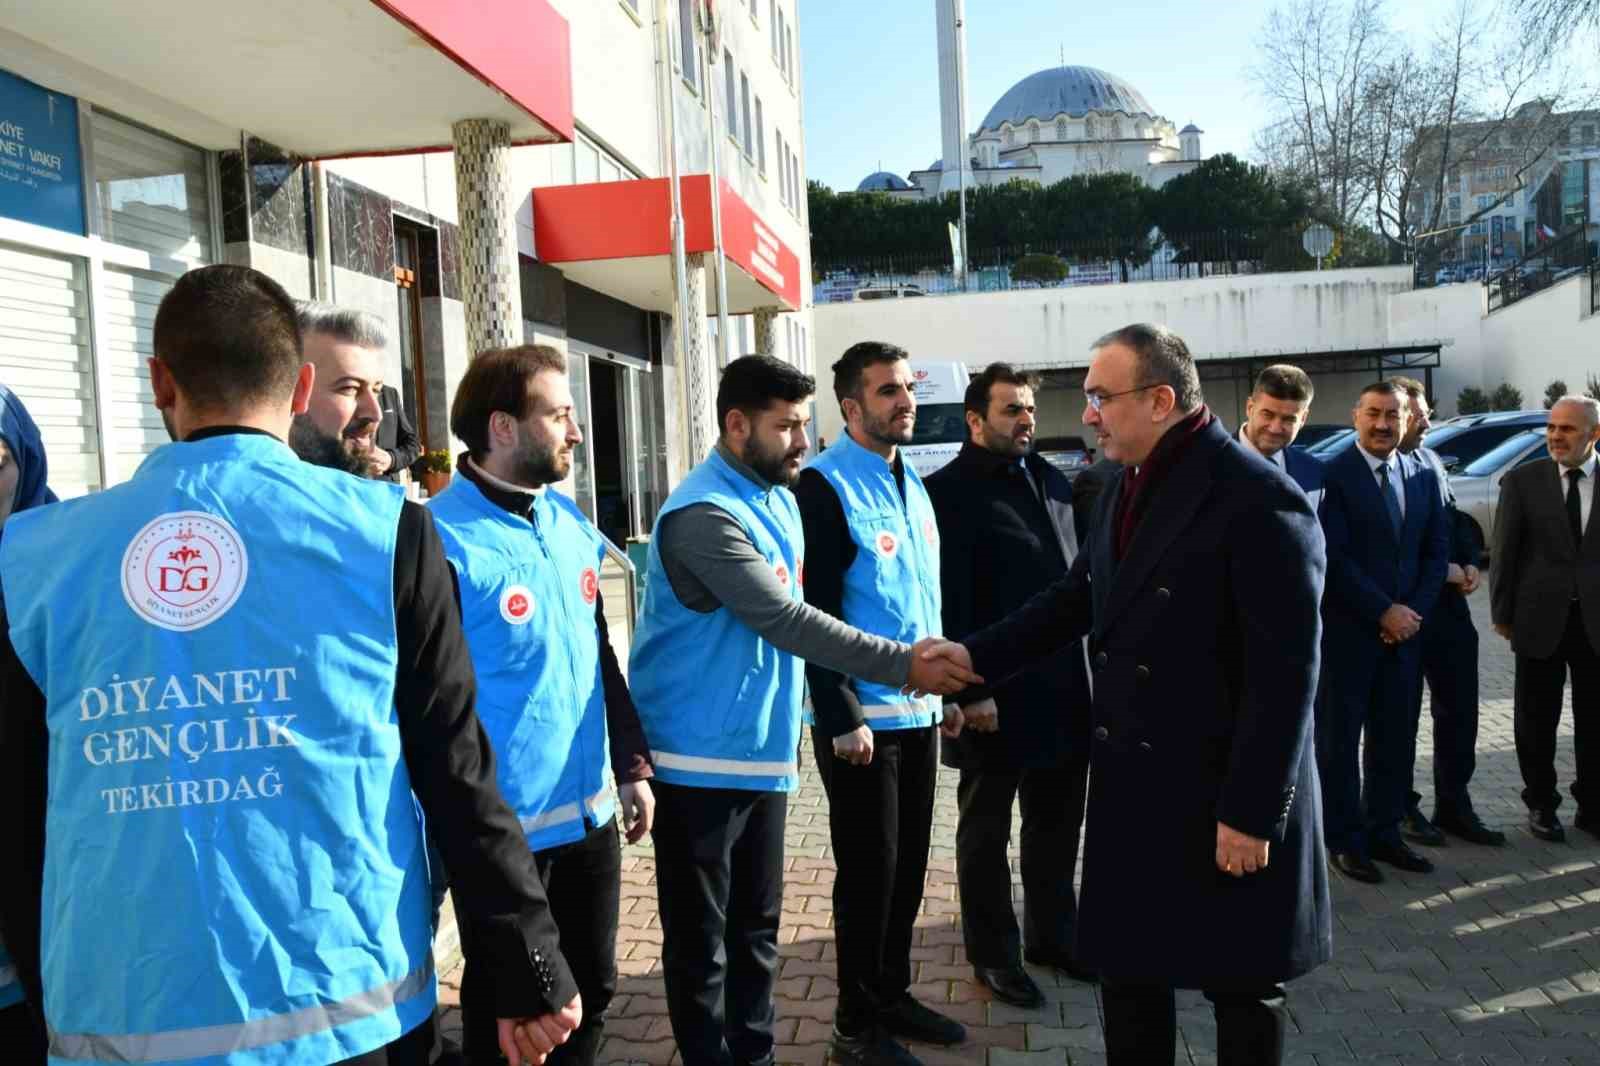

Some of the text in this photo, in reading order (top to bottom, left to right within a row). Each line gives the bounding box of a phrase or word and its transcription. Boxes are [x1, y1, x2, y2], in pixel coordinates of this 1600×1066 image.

[79, 667, 297, 721] DİYANET
[83, 708, 298, 766] GENÇLİK
[101, 766, 284, 814] TEKİRDAĞ
